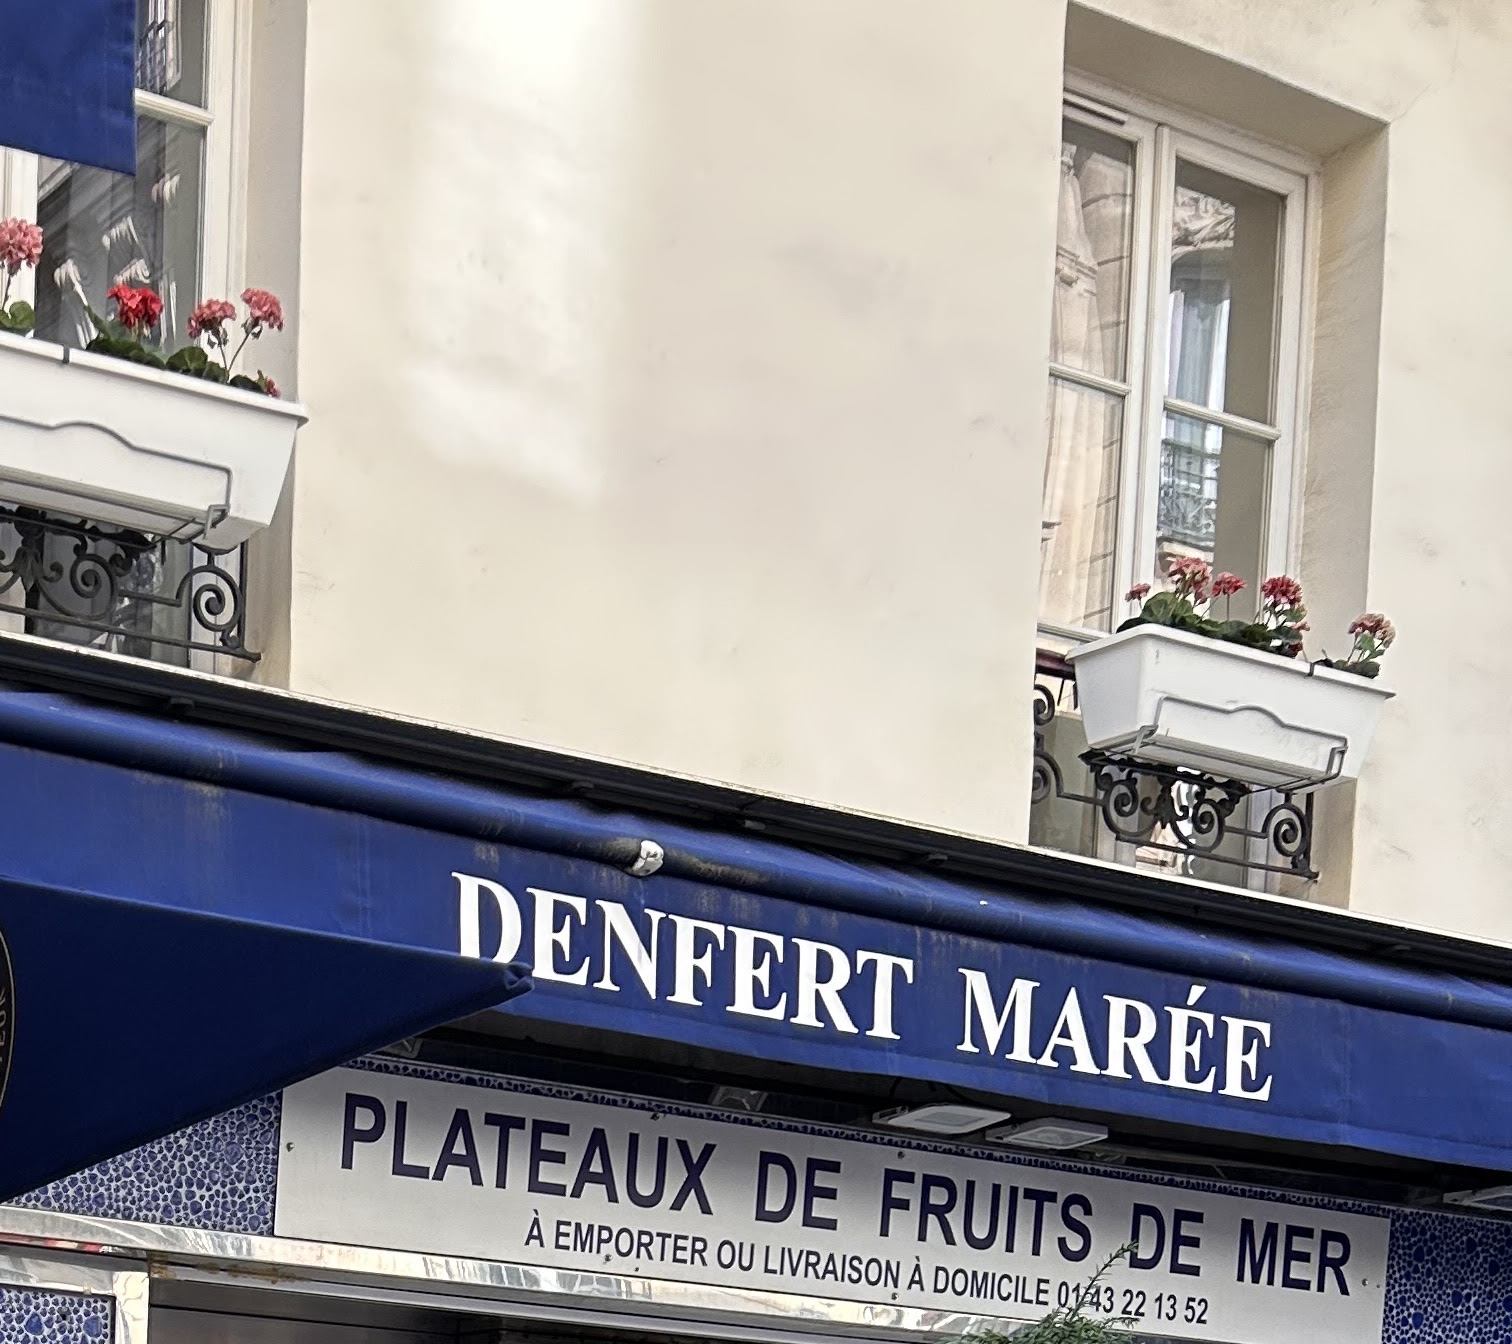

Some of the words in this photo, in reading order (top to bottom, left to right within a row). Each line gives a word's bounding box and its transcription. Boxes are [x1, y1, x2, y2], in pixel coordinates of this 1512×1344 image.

[450, 870, 915, 1041] DENFERT
[956, 967, 1274, 1102] MARÉE
[340, 1092, 718, 1217] PLATEAUX
[753, 1149, 843, 1231] DE
[879, 1166, 1094, 1264] FRUITS
[1129, 1201, 1206, 1278] DE
[1235, 1216, 1353, 1296] MER
[524, 1209, 546, 1248] À
[554, 1219, 709, 1267] EMPORTER
[716, 1238, 755, 1271] OU
[763, 1247, 901, 1290] LIVRAISON
[907, 1256, 925, 1291] À
[933, 1266, 1050, 1306] DOMICILE
[1058, 1281, 1081, 1308] 01
[1088, 1285, 1114, 1313] 43
[1121, 1289, 1147, 1317] 22
[1154, 1293, 1177, 1321] 13
[1184, 1297, 1209, 1325] 52
